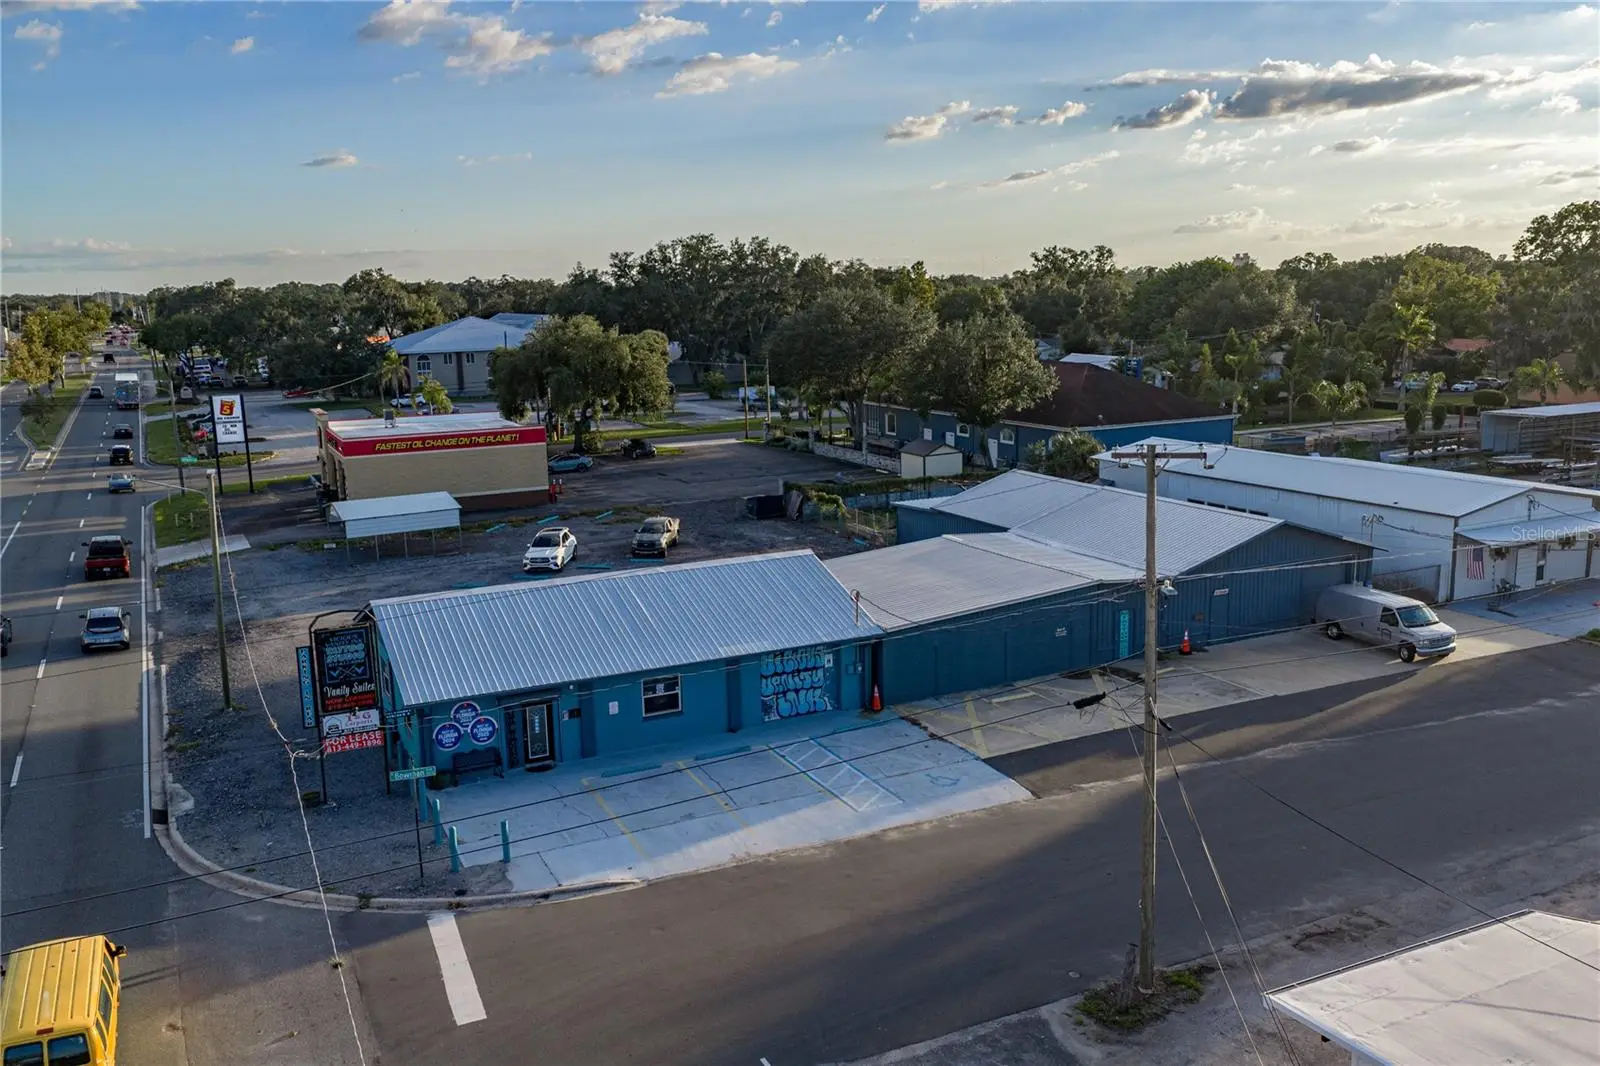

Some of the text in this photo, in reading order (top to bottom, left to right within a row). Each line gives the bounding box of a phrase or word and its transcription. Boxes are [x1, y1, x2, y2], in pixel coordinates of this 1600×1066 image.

[222, 405, 231, 415] 5
[375, 441, 412, 451] FASTEST
[412, 440, 424, 448] OIL
[424, 439, 458, 448] CHANGE
[458, 437, 470, 446] ON
[471, 436, 487, 445] THE
[324, 681, 376, 698] Vanity Suites
[325, 731, 381, 746] FOR LEASE
